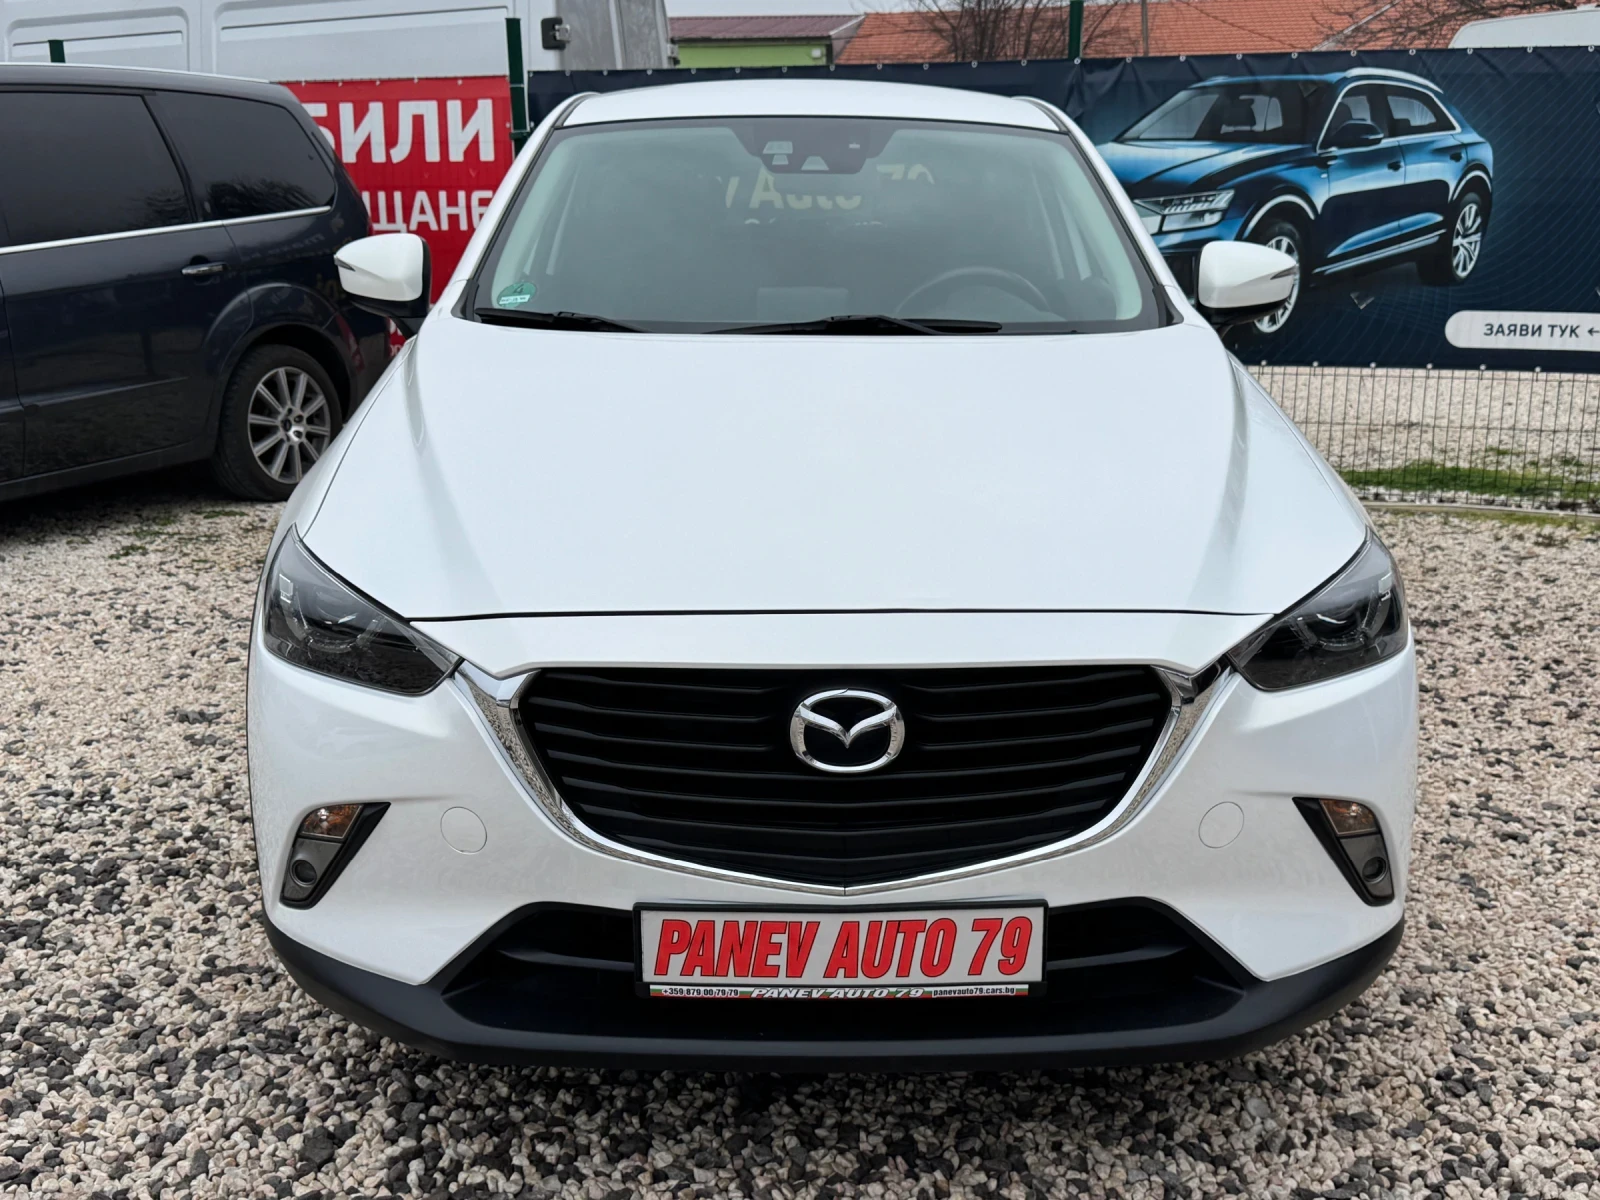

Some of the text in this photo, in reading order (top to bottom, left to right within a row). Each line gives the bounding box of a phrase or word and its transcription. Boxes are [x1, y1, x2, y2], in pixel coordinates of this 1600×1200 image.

[1483, 323, 1581, 339] ЗАЯВИ ТУК
[654, 916, 1034, 980] PANEV AUTO 79
[662, 986, 1016, 999] +359 879 00 79 79 PANEV AUTO 79 panevauto79.cars.bg
